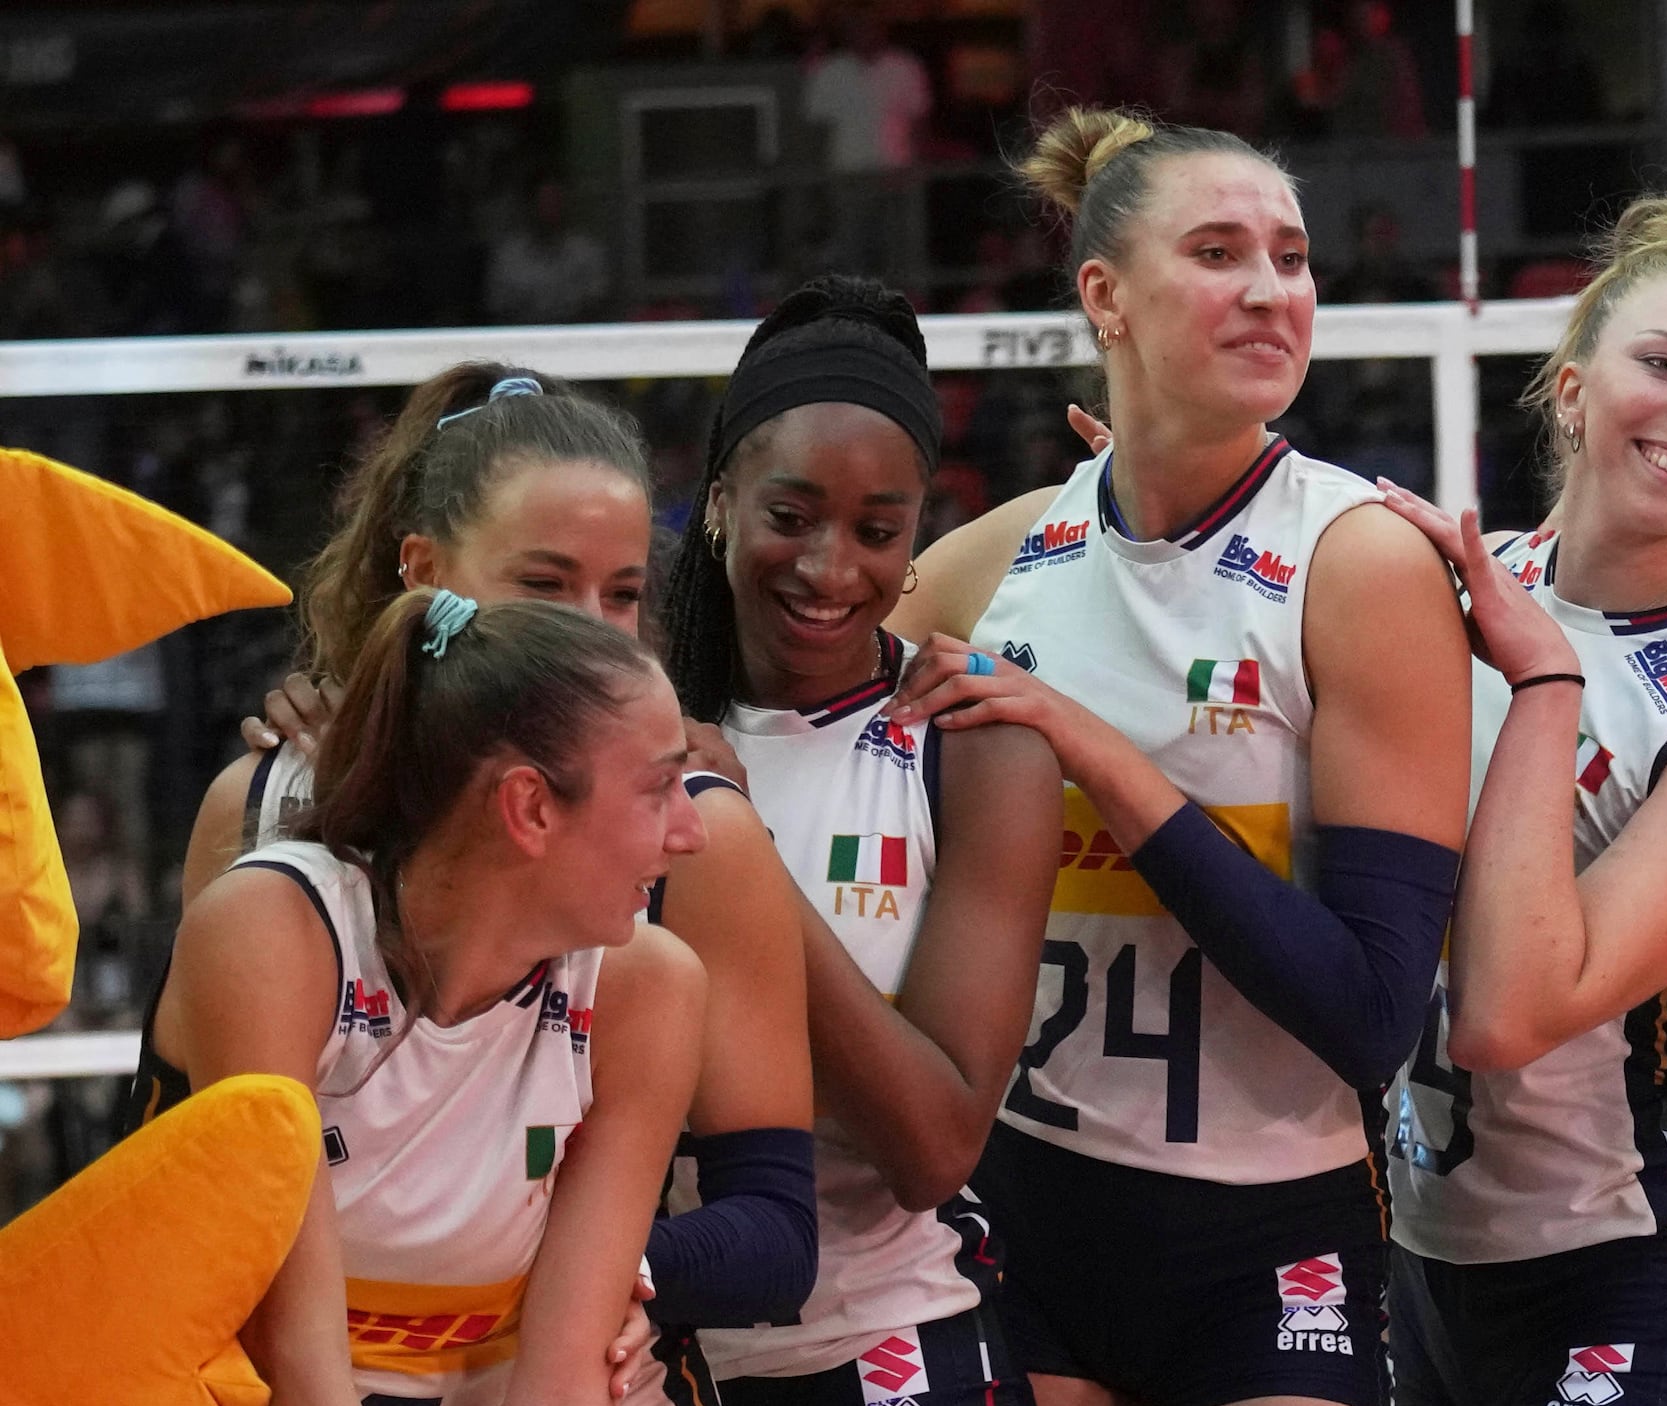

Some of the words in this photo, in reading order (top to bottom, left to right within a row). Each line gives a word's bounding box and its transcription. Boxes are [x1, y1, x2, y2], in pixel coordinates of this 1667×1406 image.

[1047, 550, 1087, 567] BUILDERS
[1221, 534, 1296, 586] BigMat
[1188, 706, 1256, 736] ITA
[834, 886, 900, 921] ITA
[1002, 938, 1199, 1144] 24
